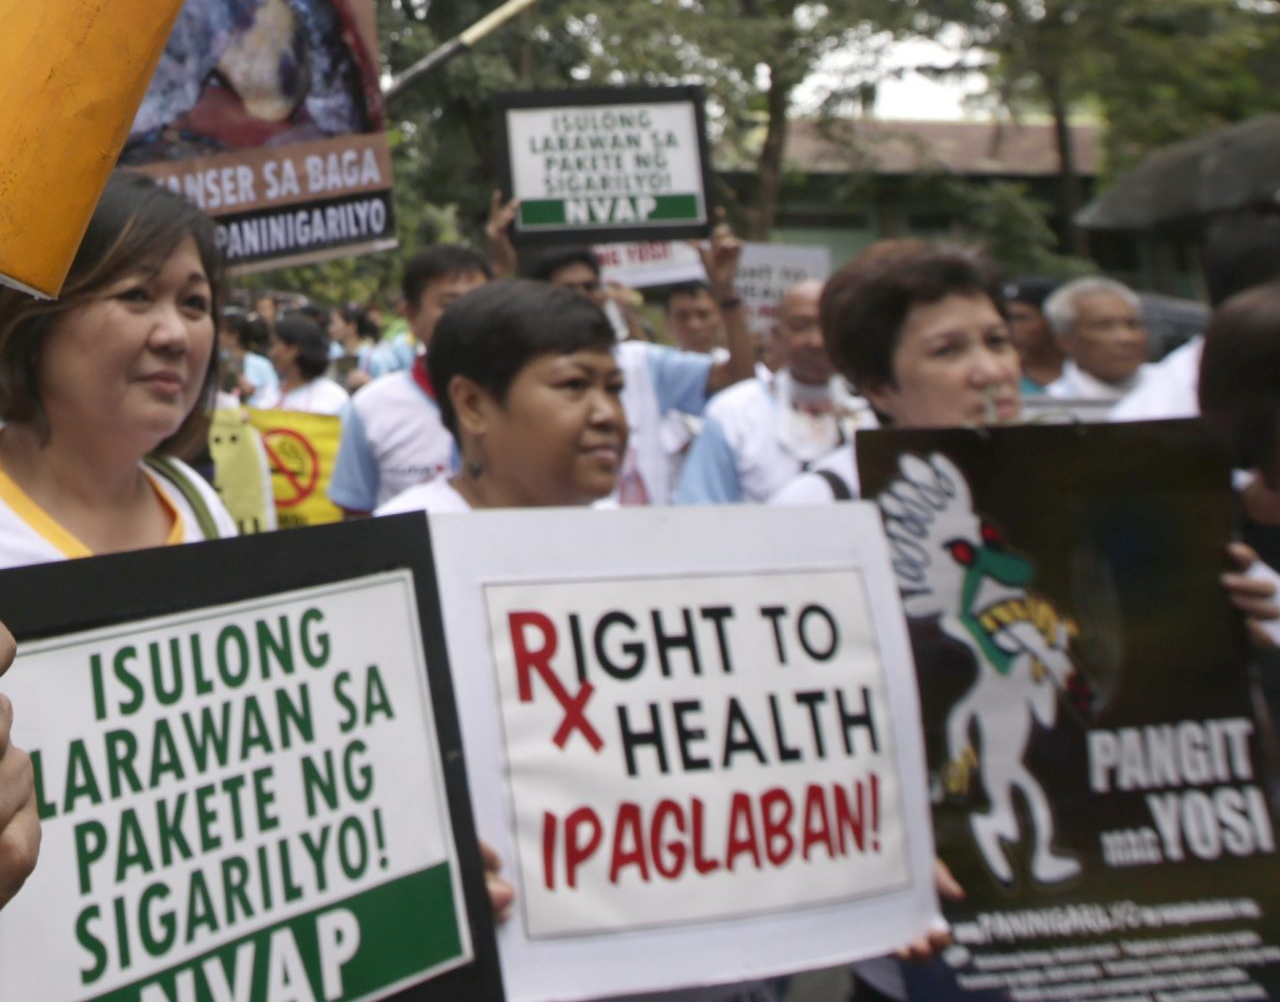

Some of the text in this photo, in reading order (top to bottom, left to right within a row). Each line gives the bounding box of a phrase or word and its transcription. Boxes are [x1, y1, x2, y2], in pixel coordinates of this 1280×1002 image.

[529, 133, 641, 154] LARAWAN
[552, 110, 652, 132] ISULONG
[156, 147, 381, 211] ANSER SA BAGA
[545, 153, 624, 172] PAKETE
[214, 198, 387, 258] PANINIGARILYO
[565, 196, 657, 225] NVAP
[89, 608, 331, 721] ISULONG
[508, 604, 839, 708] RIGHT TO
[29, 664, 395, 820] LARAWAN SA
[616, 686, 881, 778] HEALTH
[1086, 716, 1255, 794] PANGIT
[73, 739, 374, 895] PAKETE NG
[541, 771, 883, 891] IPAGLABAN!
[1145, 784, 1276, 862] YOSI
[74, 807, 390, 986] SIGARILYO!
